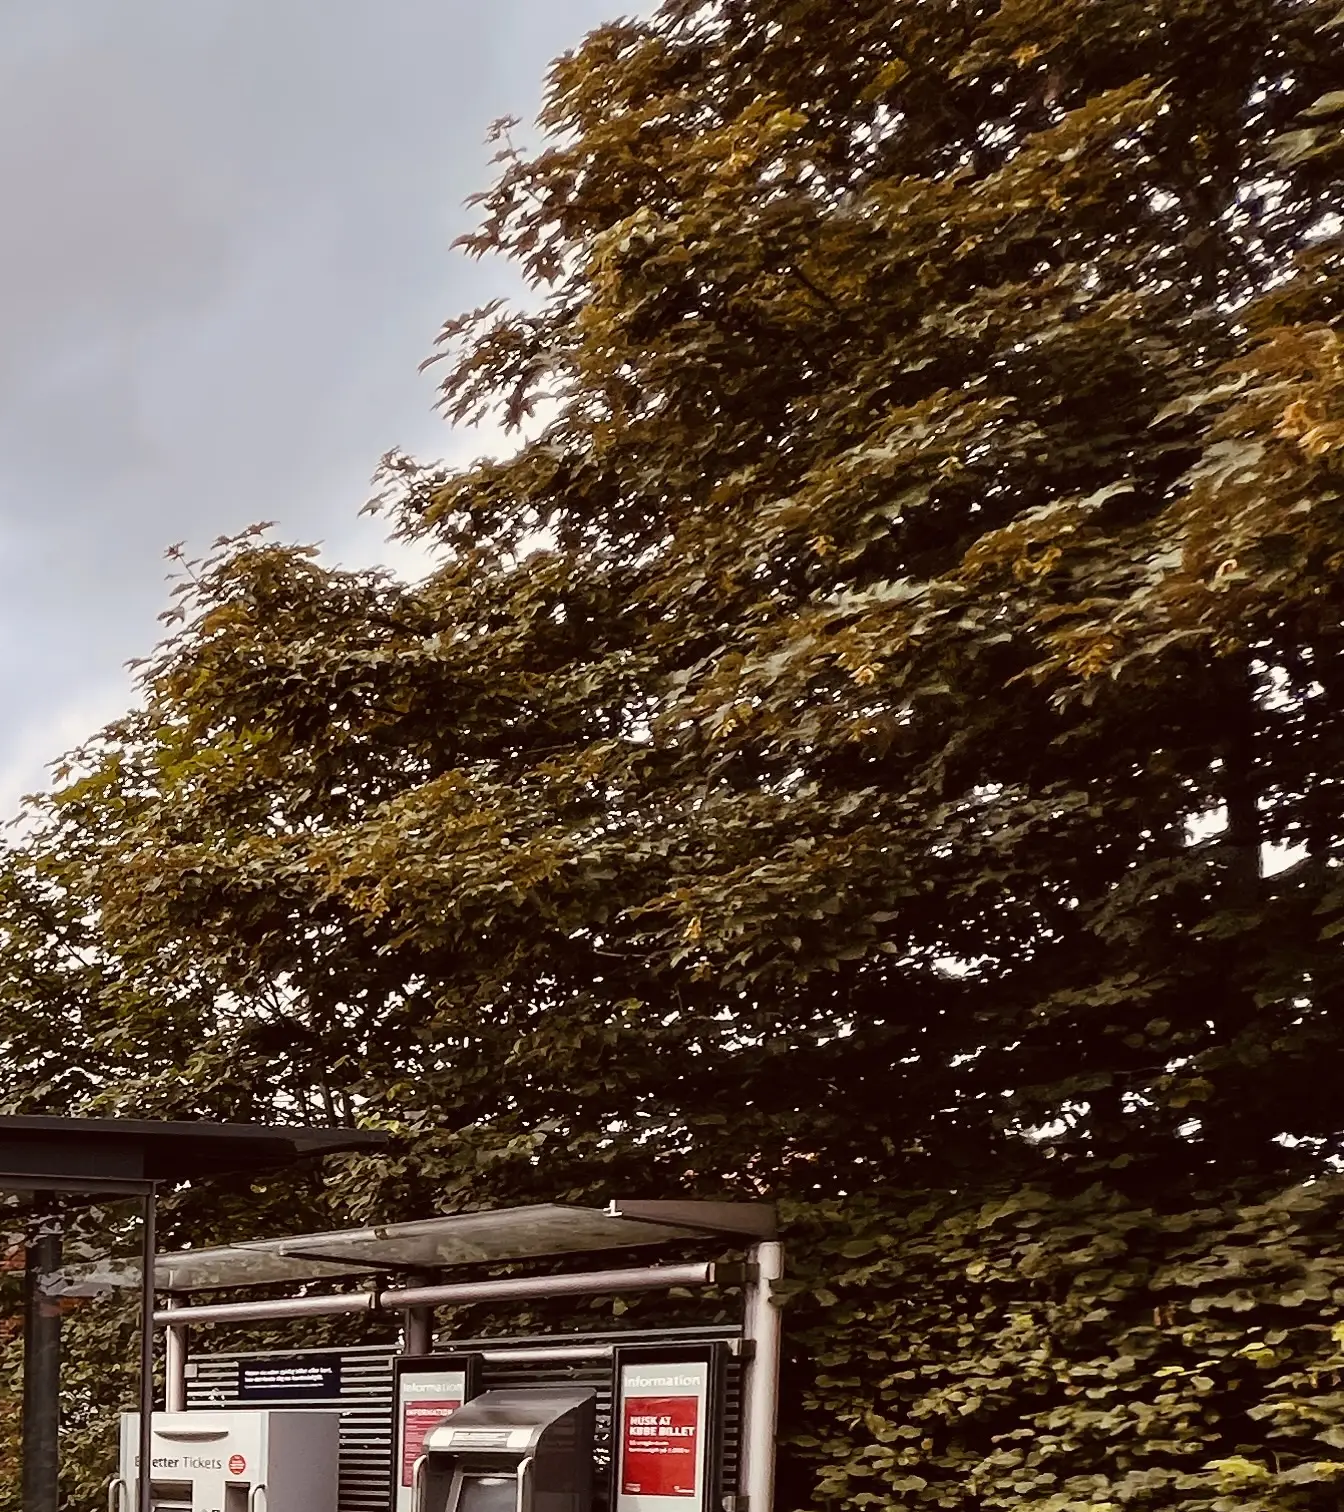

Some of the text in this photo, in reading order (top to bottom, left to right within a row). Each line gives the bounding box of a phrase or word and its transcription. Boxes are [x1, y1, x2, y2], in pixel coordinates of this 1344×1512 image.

[624, 1375, 701, 1388] Information
[630, 1416, 671, 1426] HUSK AT
[658, 1426, 695, 1437] BILLET
[182, 1456, 222, 1469] Tickets
